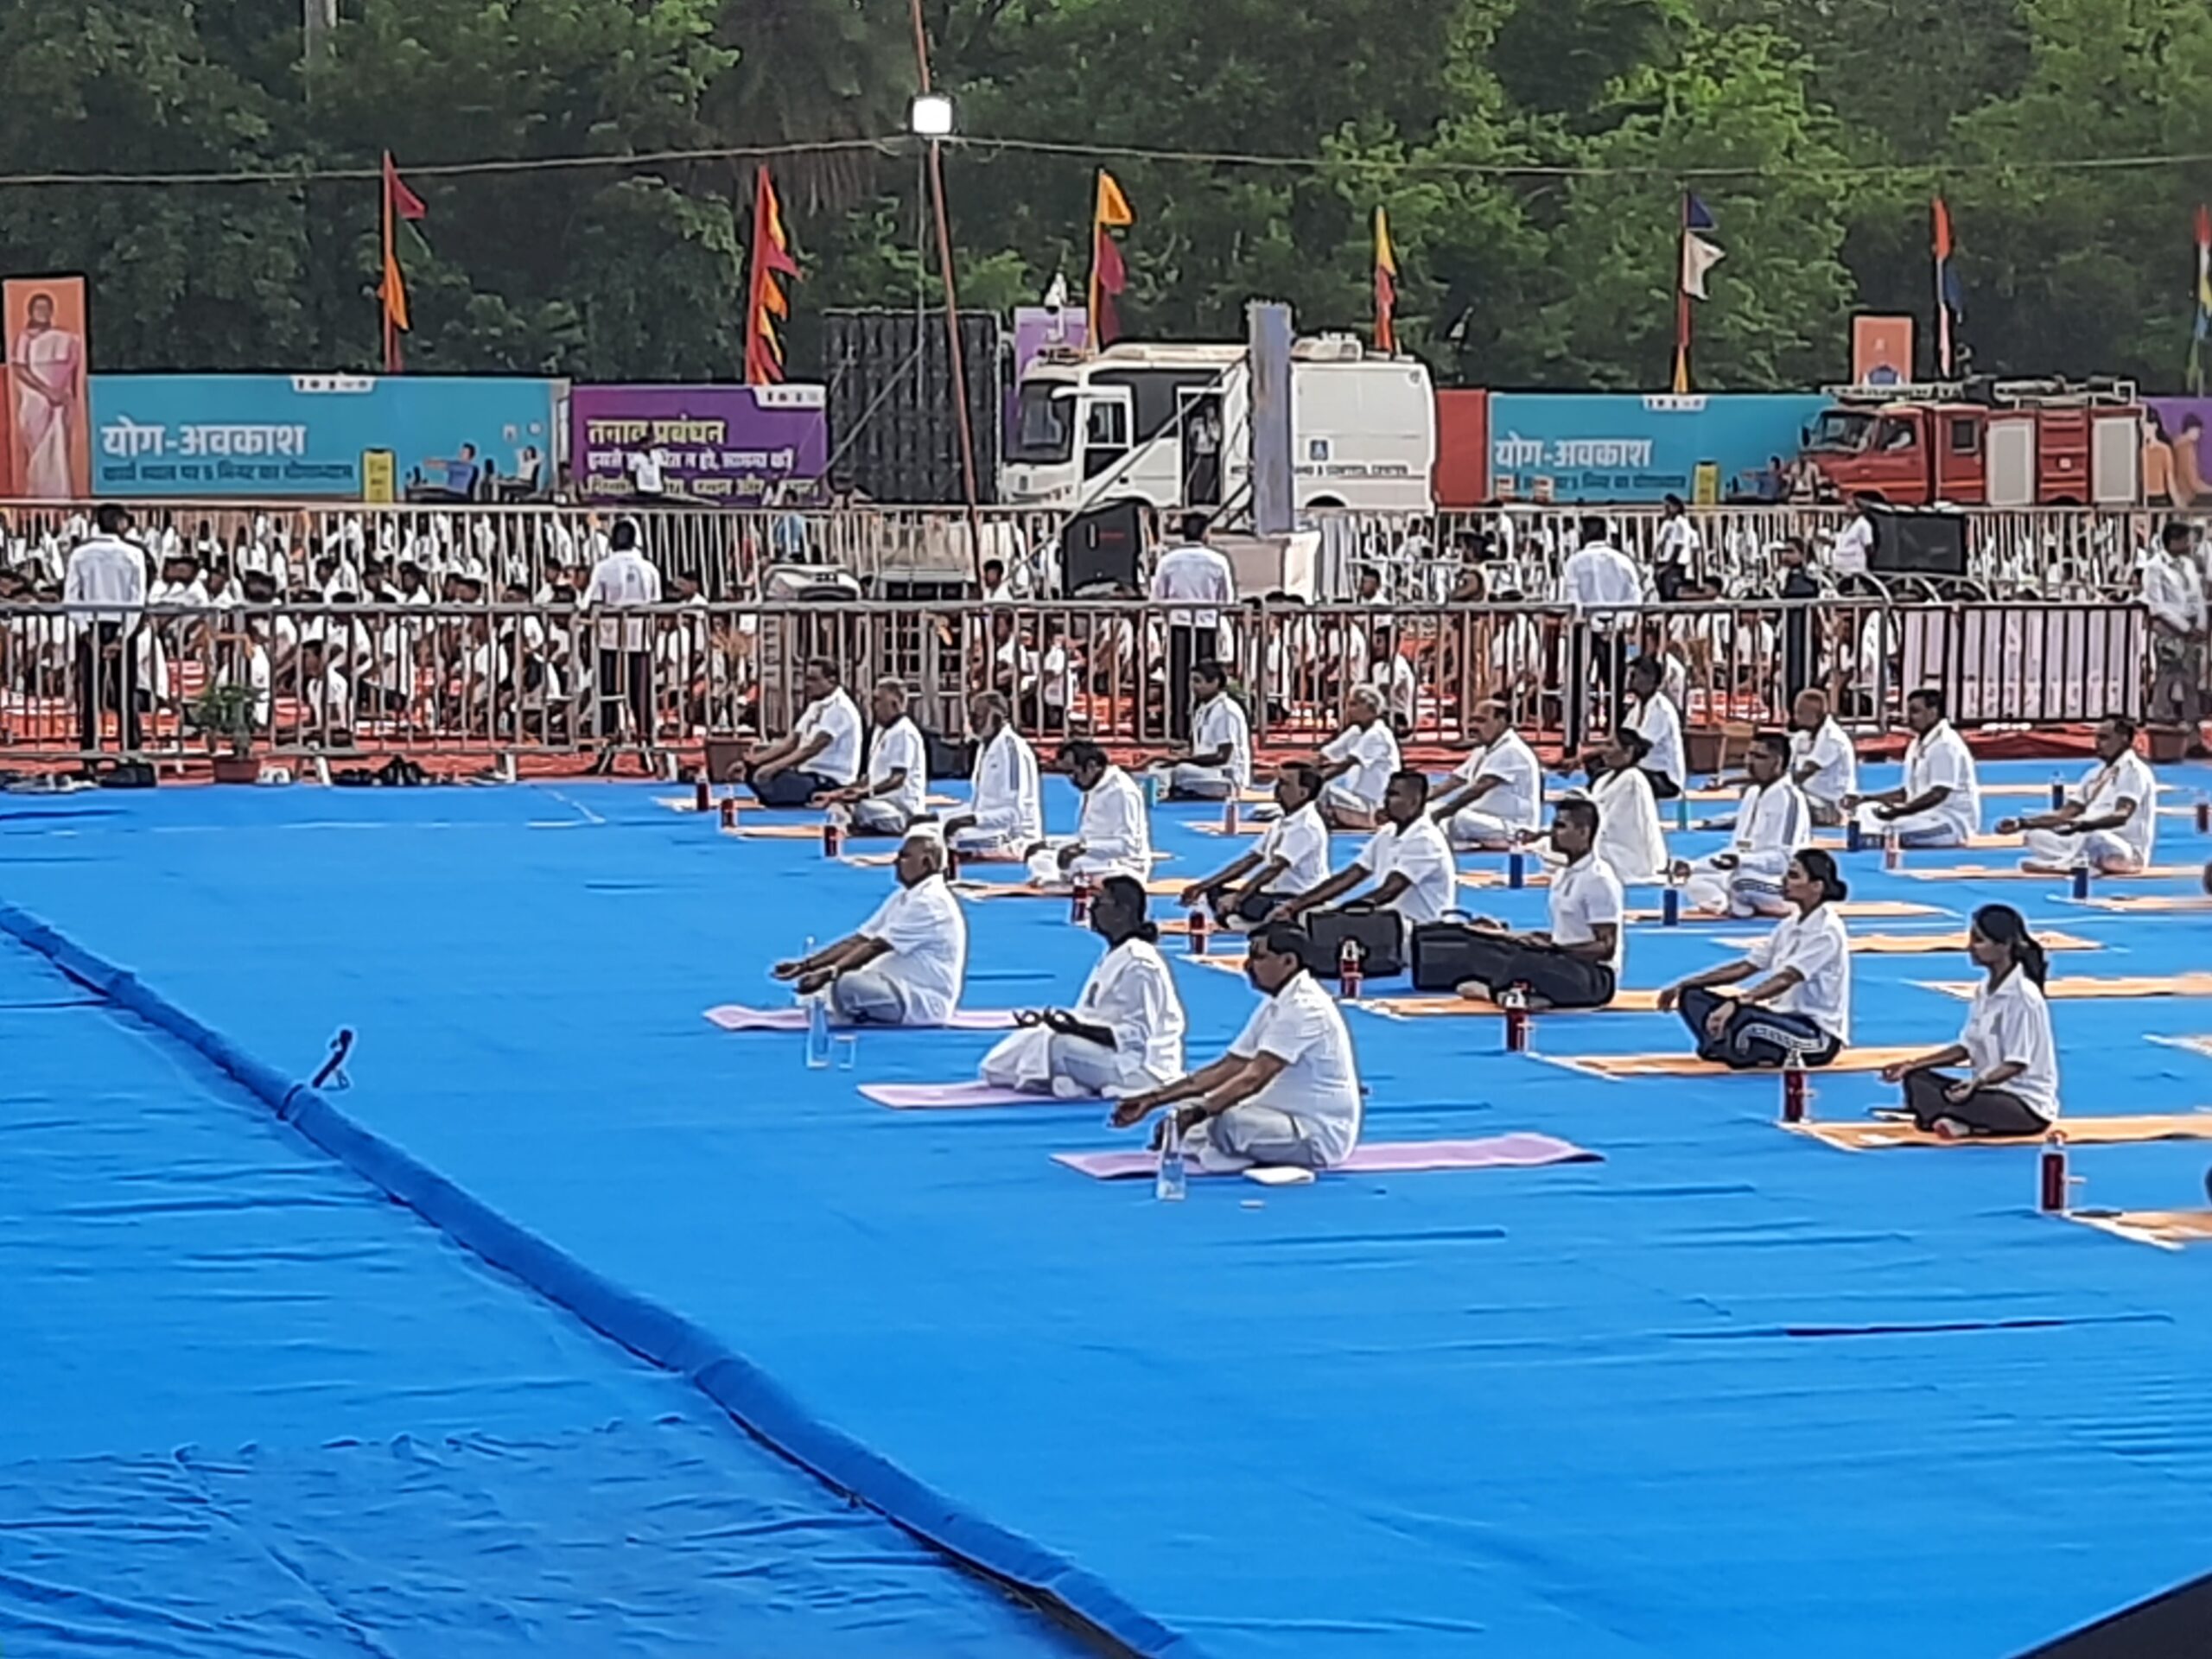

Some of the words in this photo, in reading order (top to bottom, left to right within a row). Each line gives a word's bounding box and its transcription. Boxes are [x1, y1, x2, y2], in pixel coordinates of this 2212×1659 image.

[100, 415, 307, 457] योग-अवकाश
[587, 419, 648, 444] तनाव
[1495, 430, 1653, 468] योग-अवकाश
